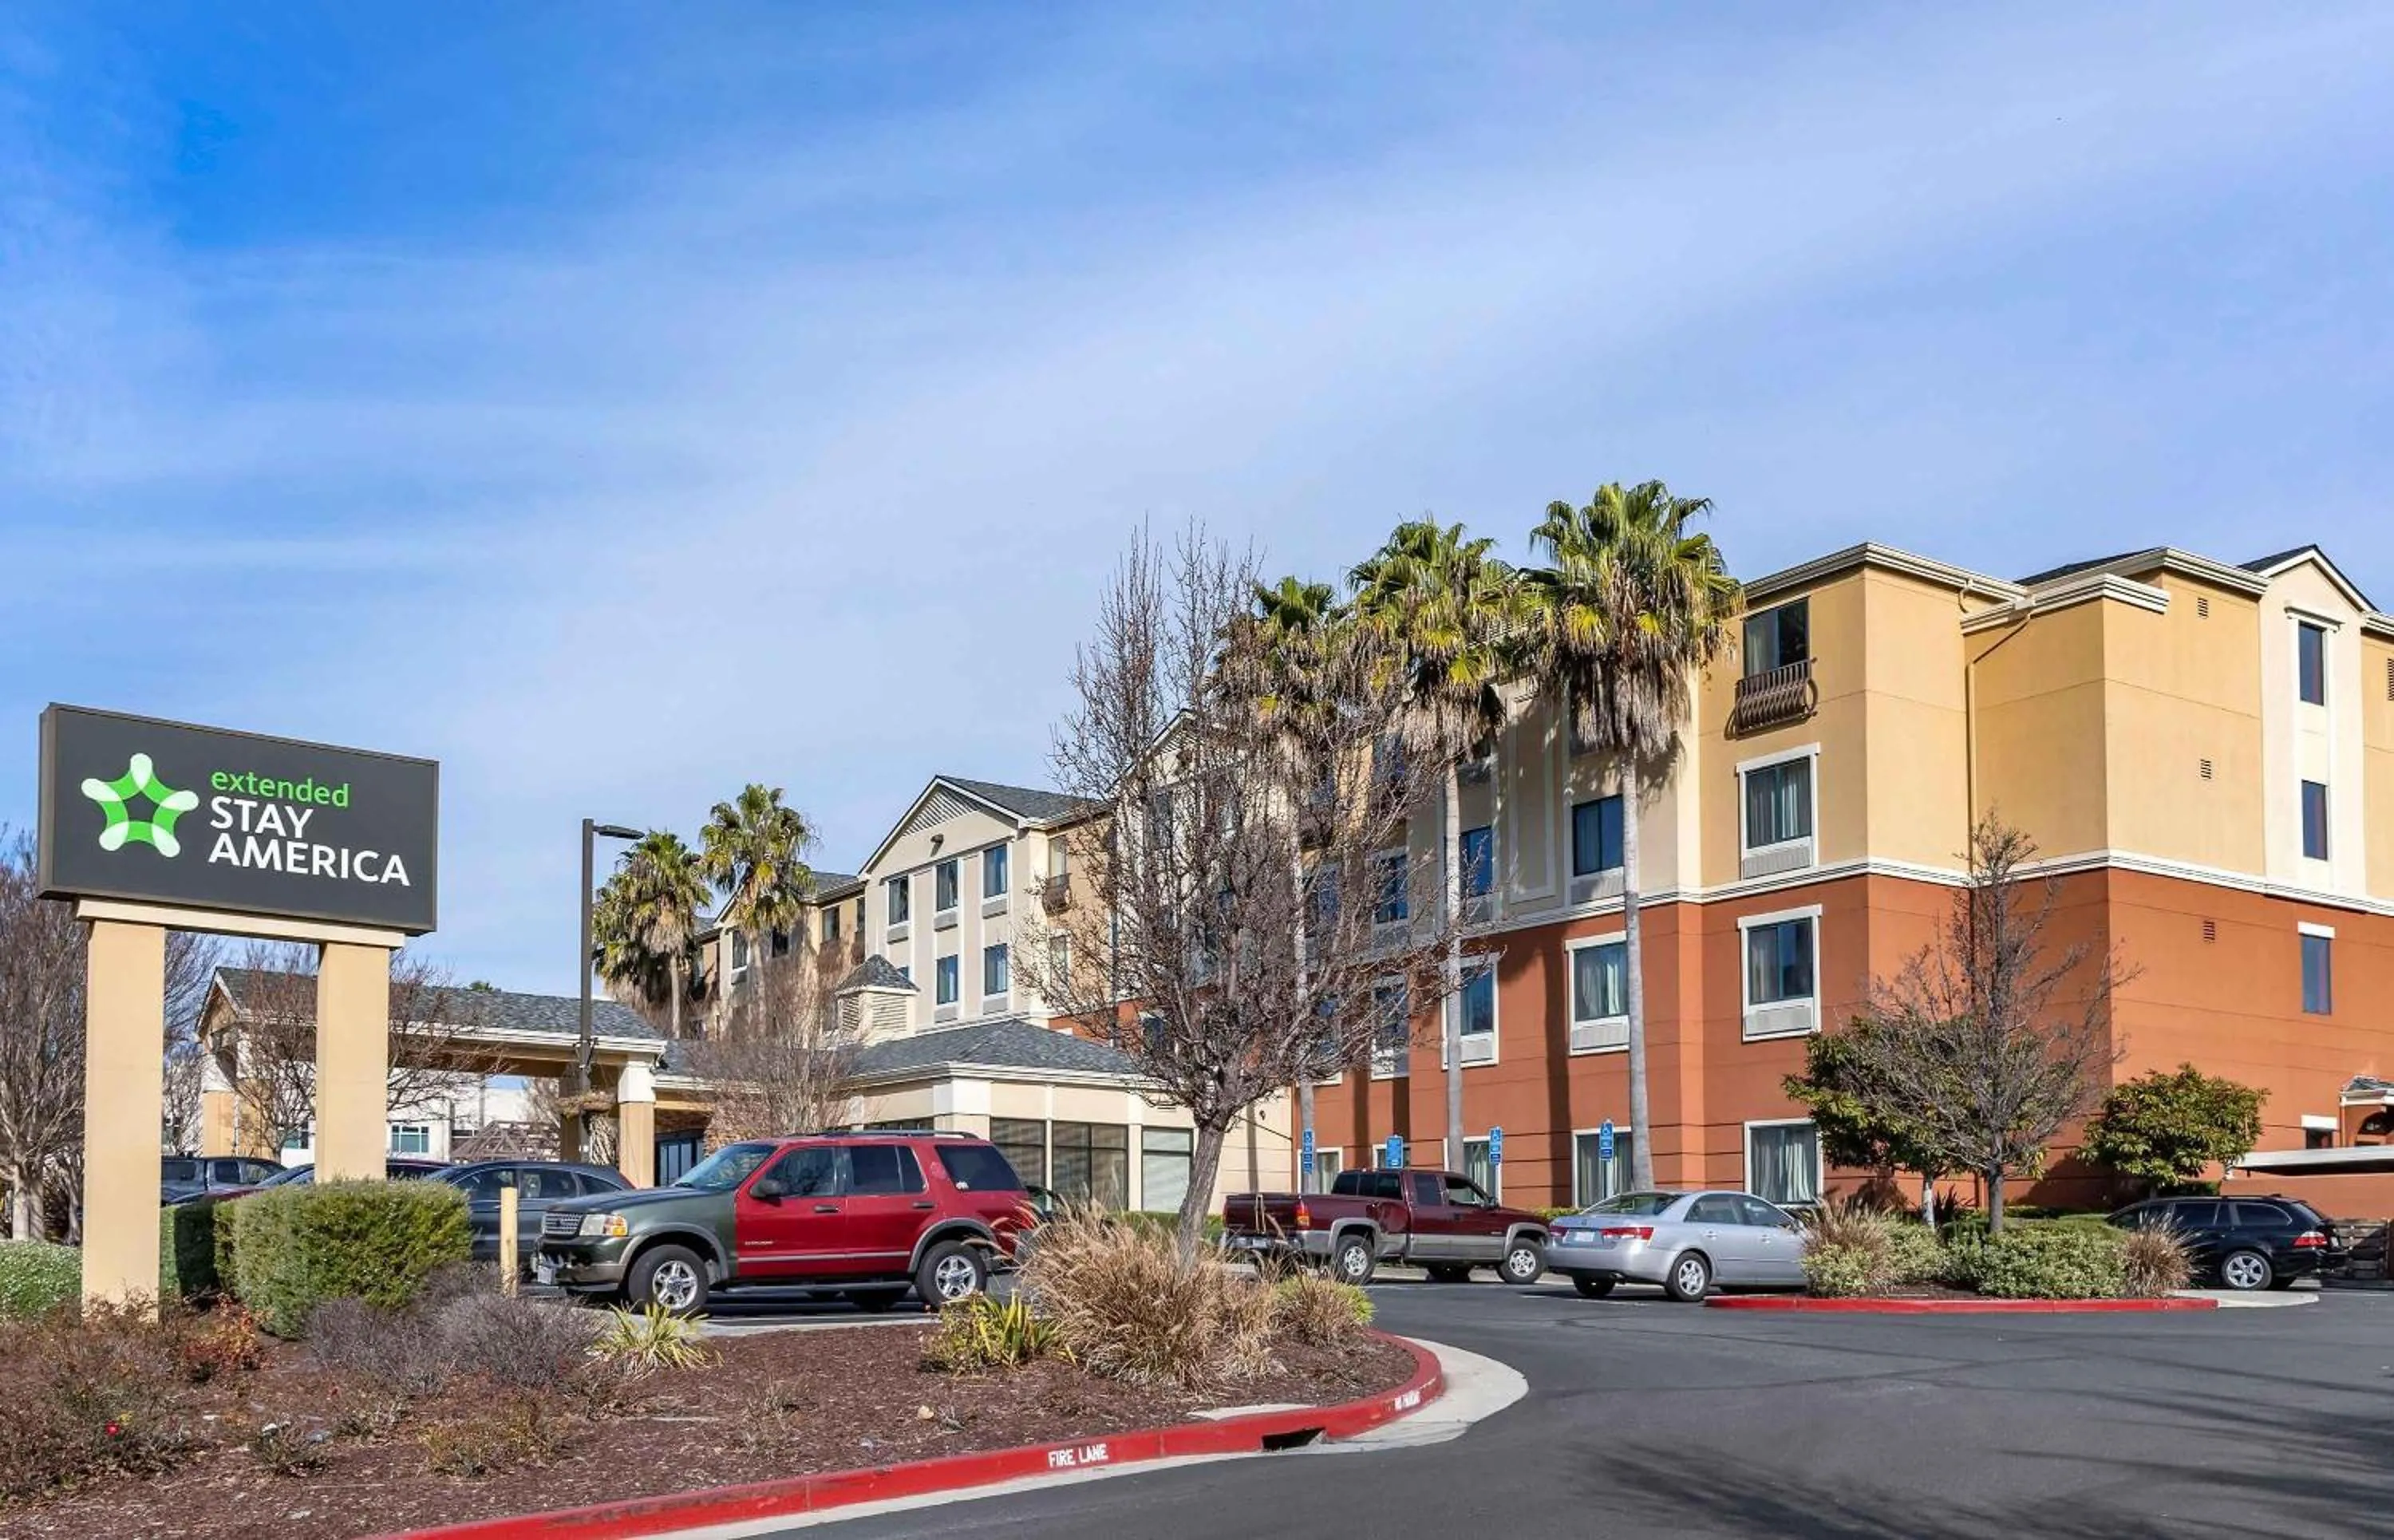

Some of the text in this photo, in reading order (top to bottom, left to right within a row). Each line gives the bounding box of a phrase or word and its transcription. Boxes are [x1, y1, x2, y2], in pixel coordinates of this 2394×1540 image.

[211, 771, 350, 808] extended
[210, 796, 314, 839] STAY
[208, 832, 411, 886] AMERICA
[1048, 1443, 1109, 1468] FIRE LANE
